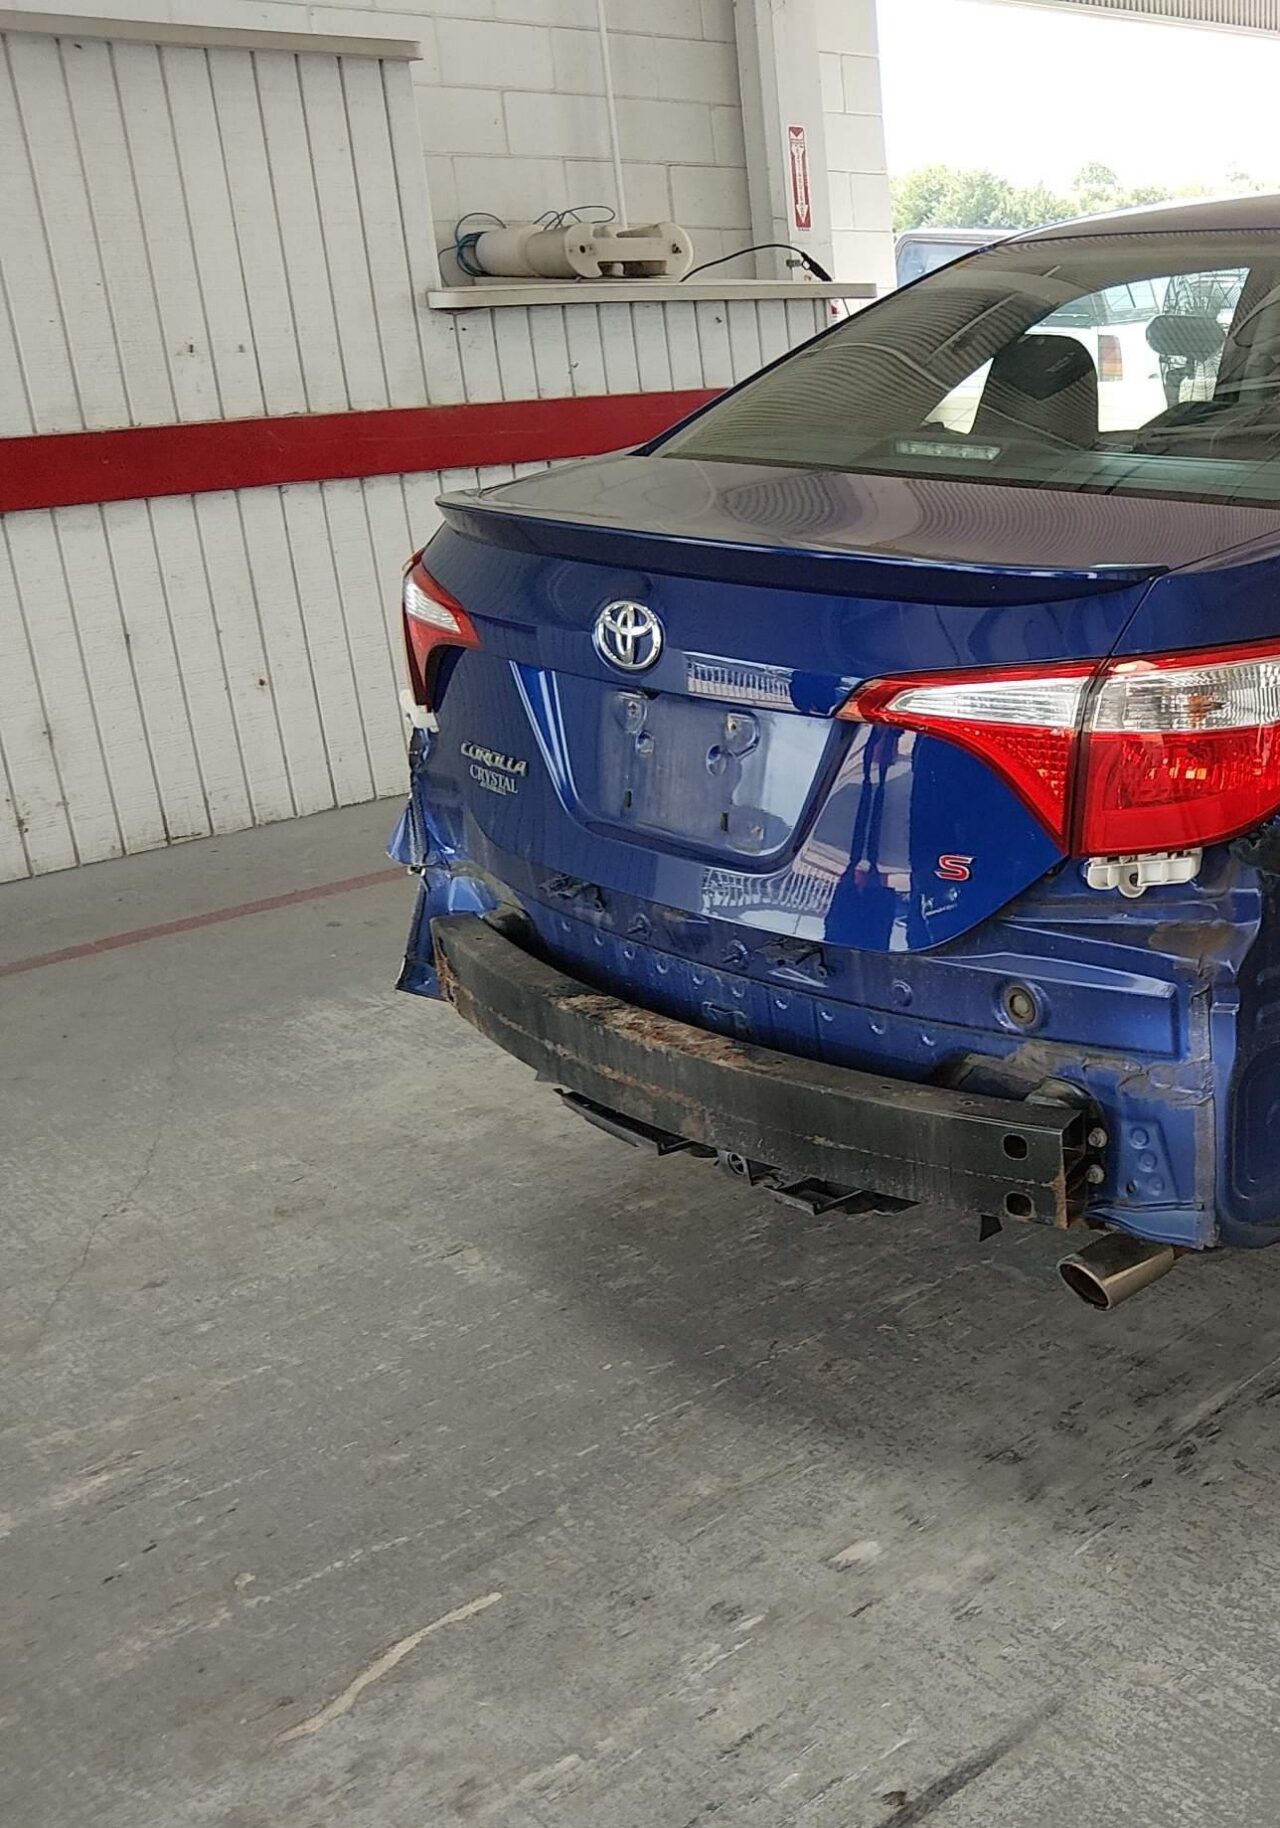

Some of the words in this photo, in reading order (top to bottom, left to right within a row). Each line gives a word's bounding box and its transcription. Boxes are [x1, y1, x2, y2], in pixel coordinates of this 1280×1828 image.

[460, 740, 528, 777] COROLLA
[469, 764, 518, 794] CRYSTAL
[933, 854, 975, 881] S
